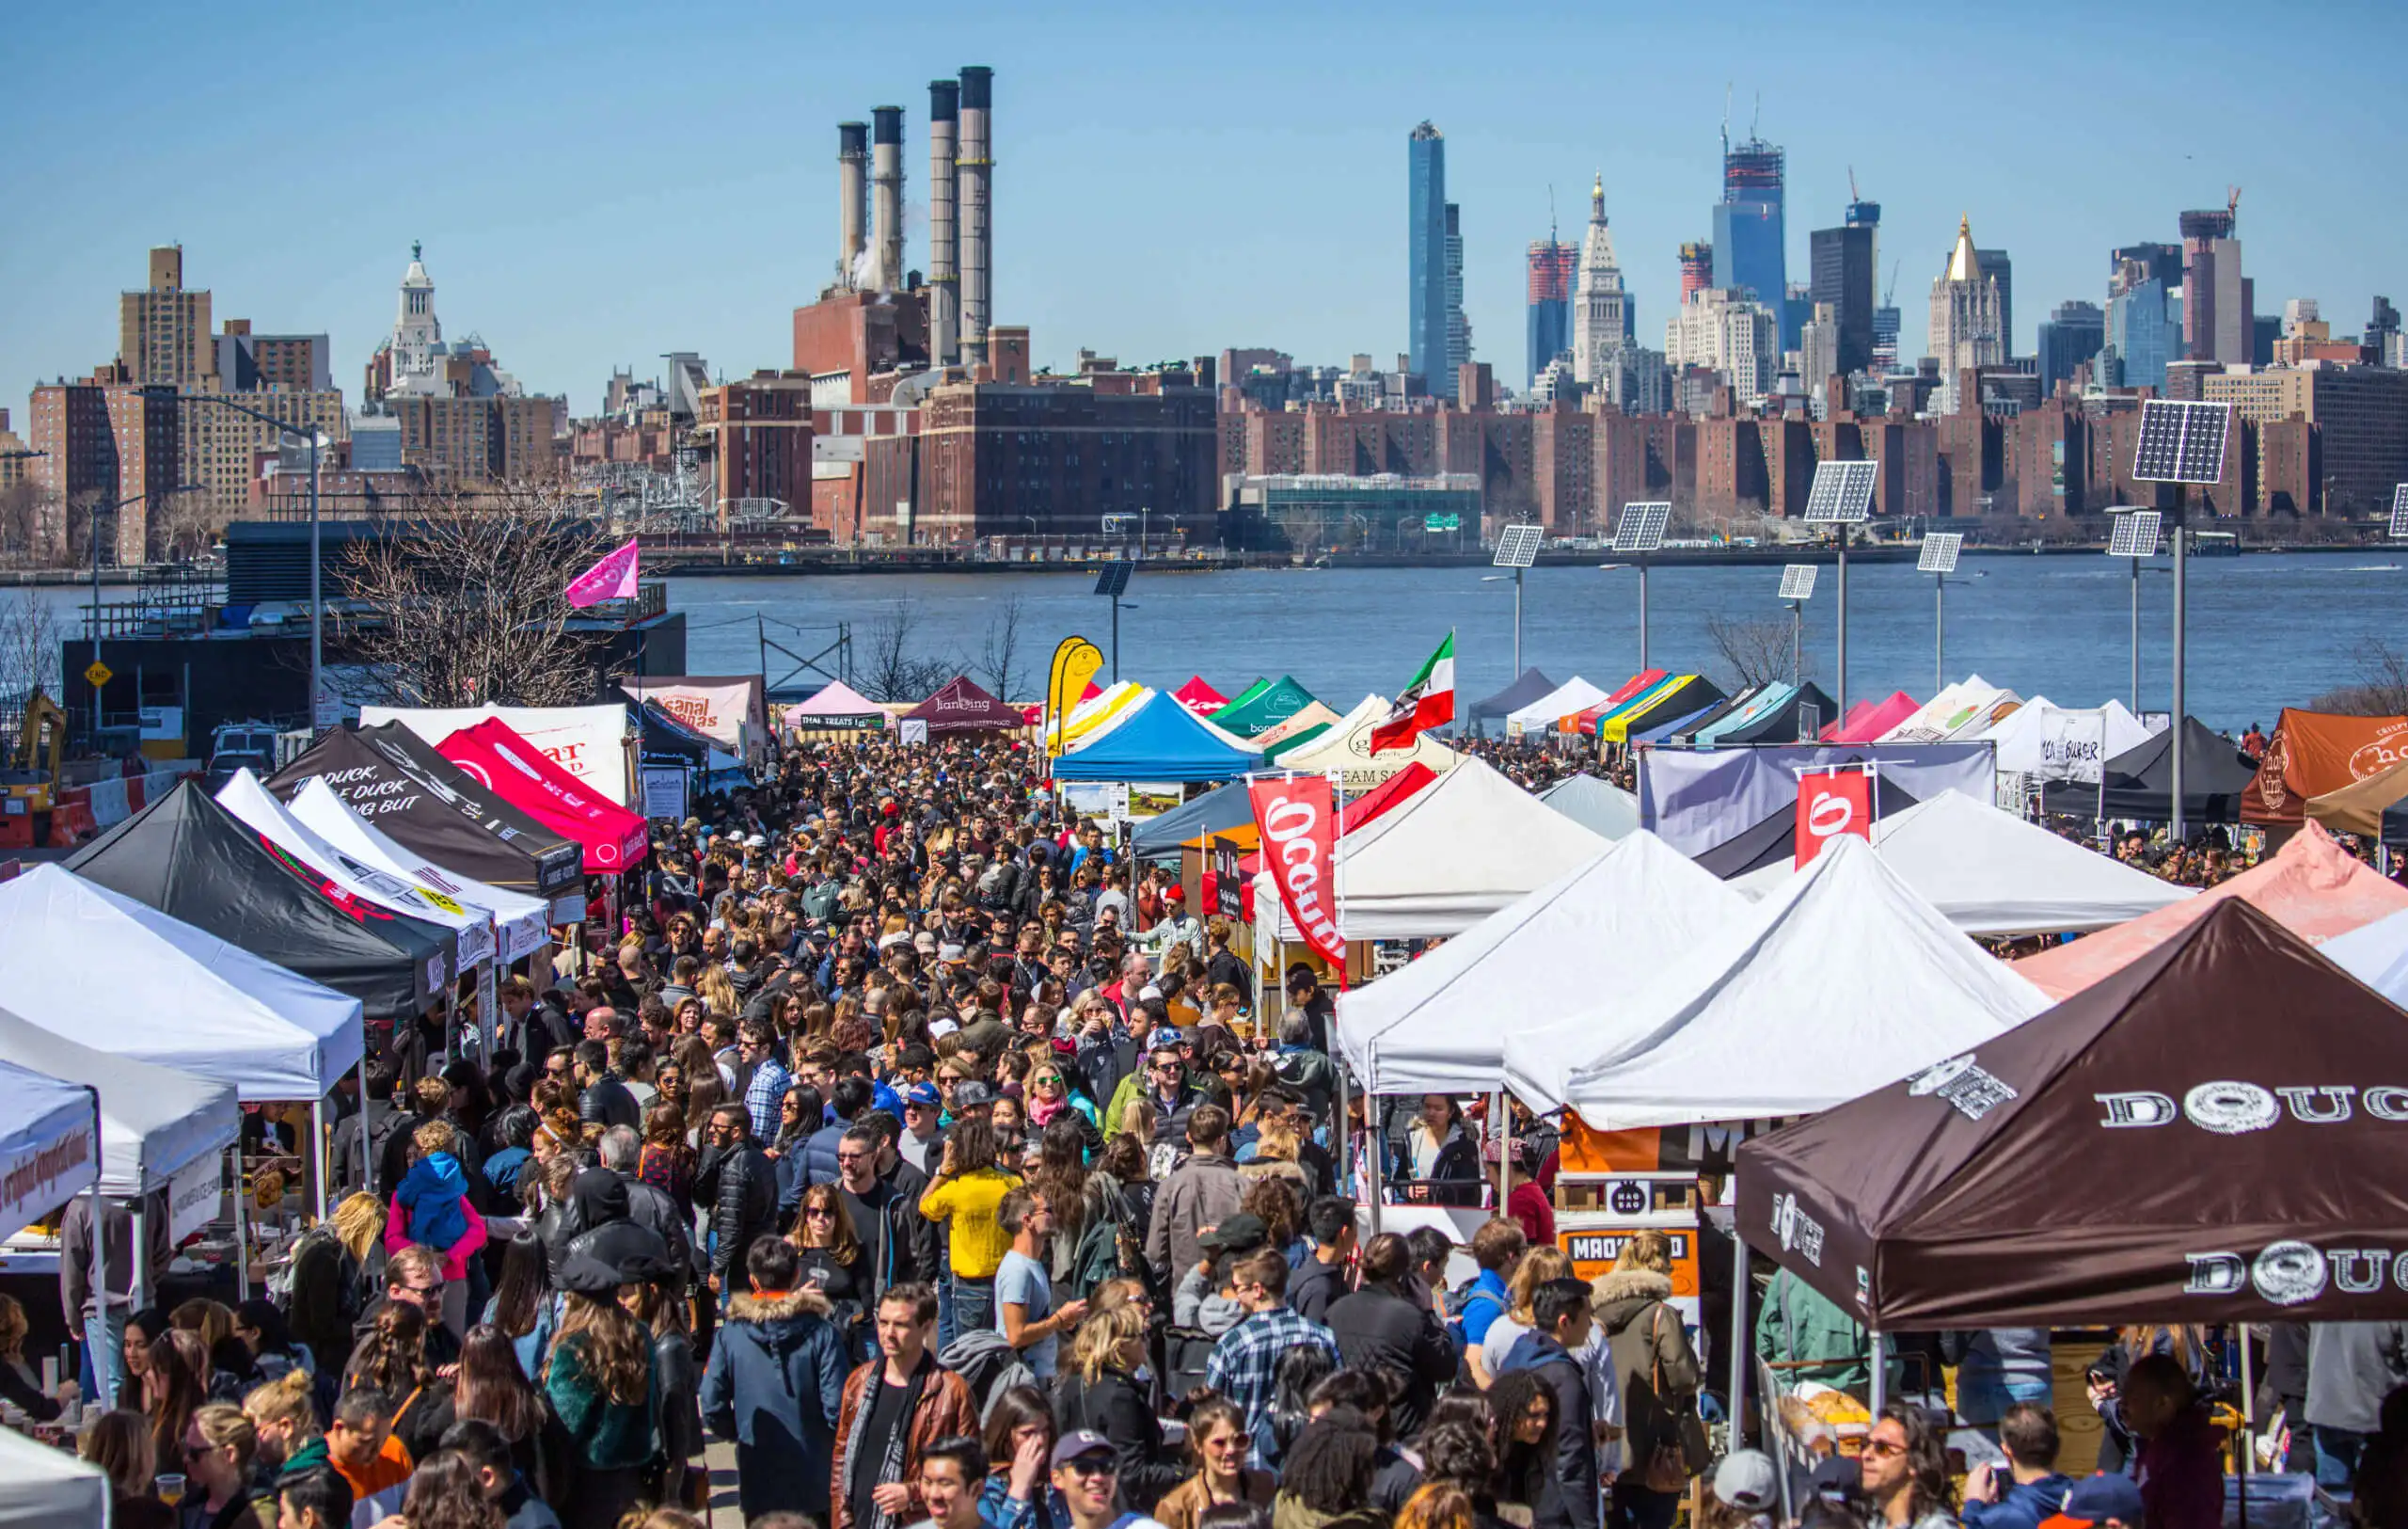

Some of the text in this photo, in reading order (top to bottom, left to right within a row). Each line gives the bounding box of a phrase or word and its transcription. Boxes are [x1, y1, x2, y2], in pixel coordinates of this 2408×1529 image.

[88, 669, 107, 679] END
[353, 779, 410, 799] DUCK
[378, 795, 422, 814] BUT
[1573, 1236, 1630, 1260] MAO'
[2182, 1239, 2408, 1306] DOU
